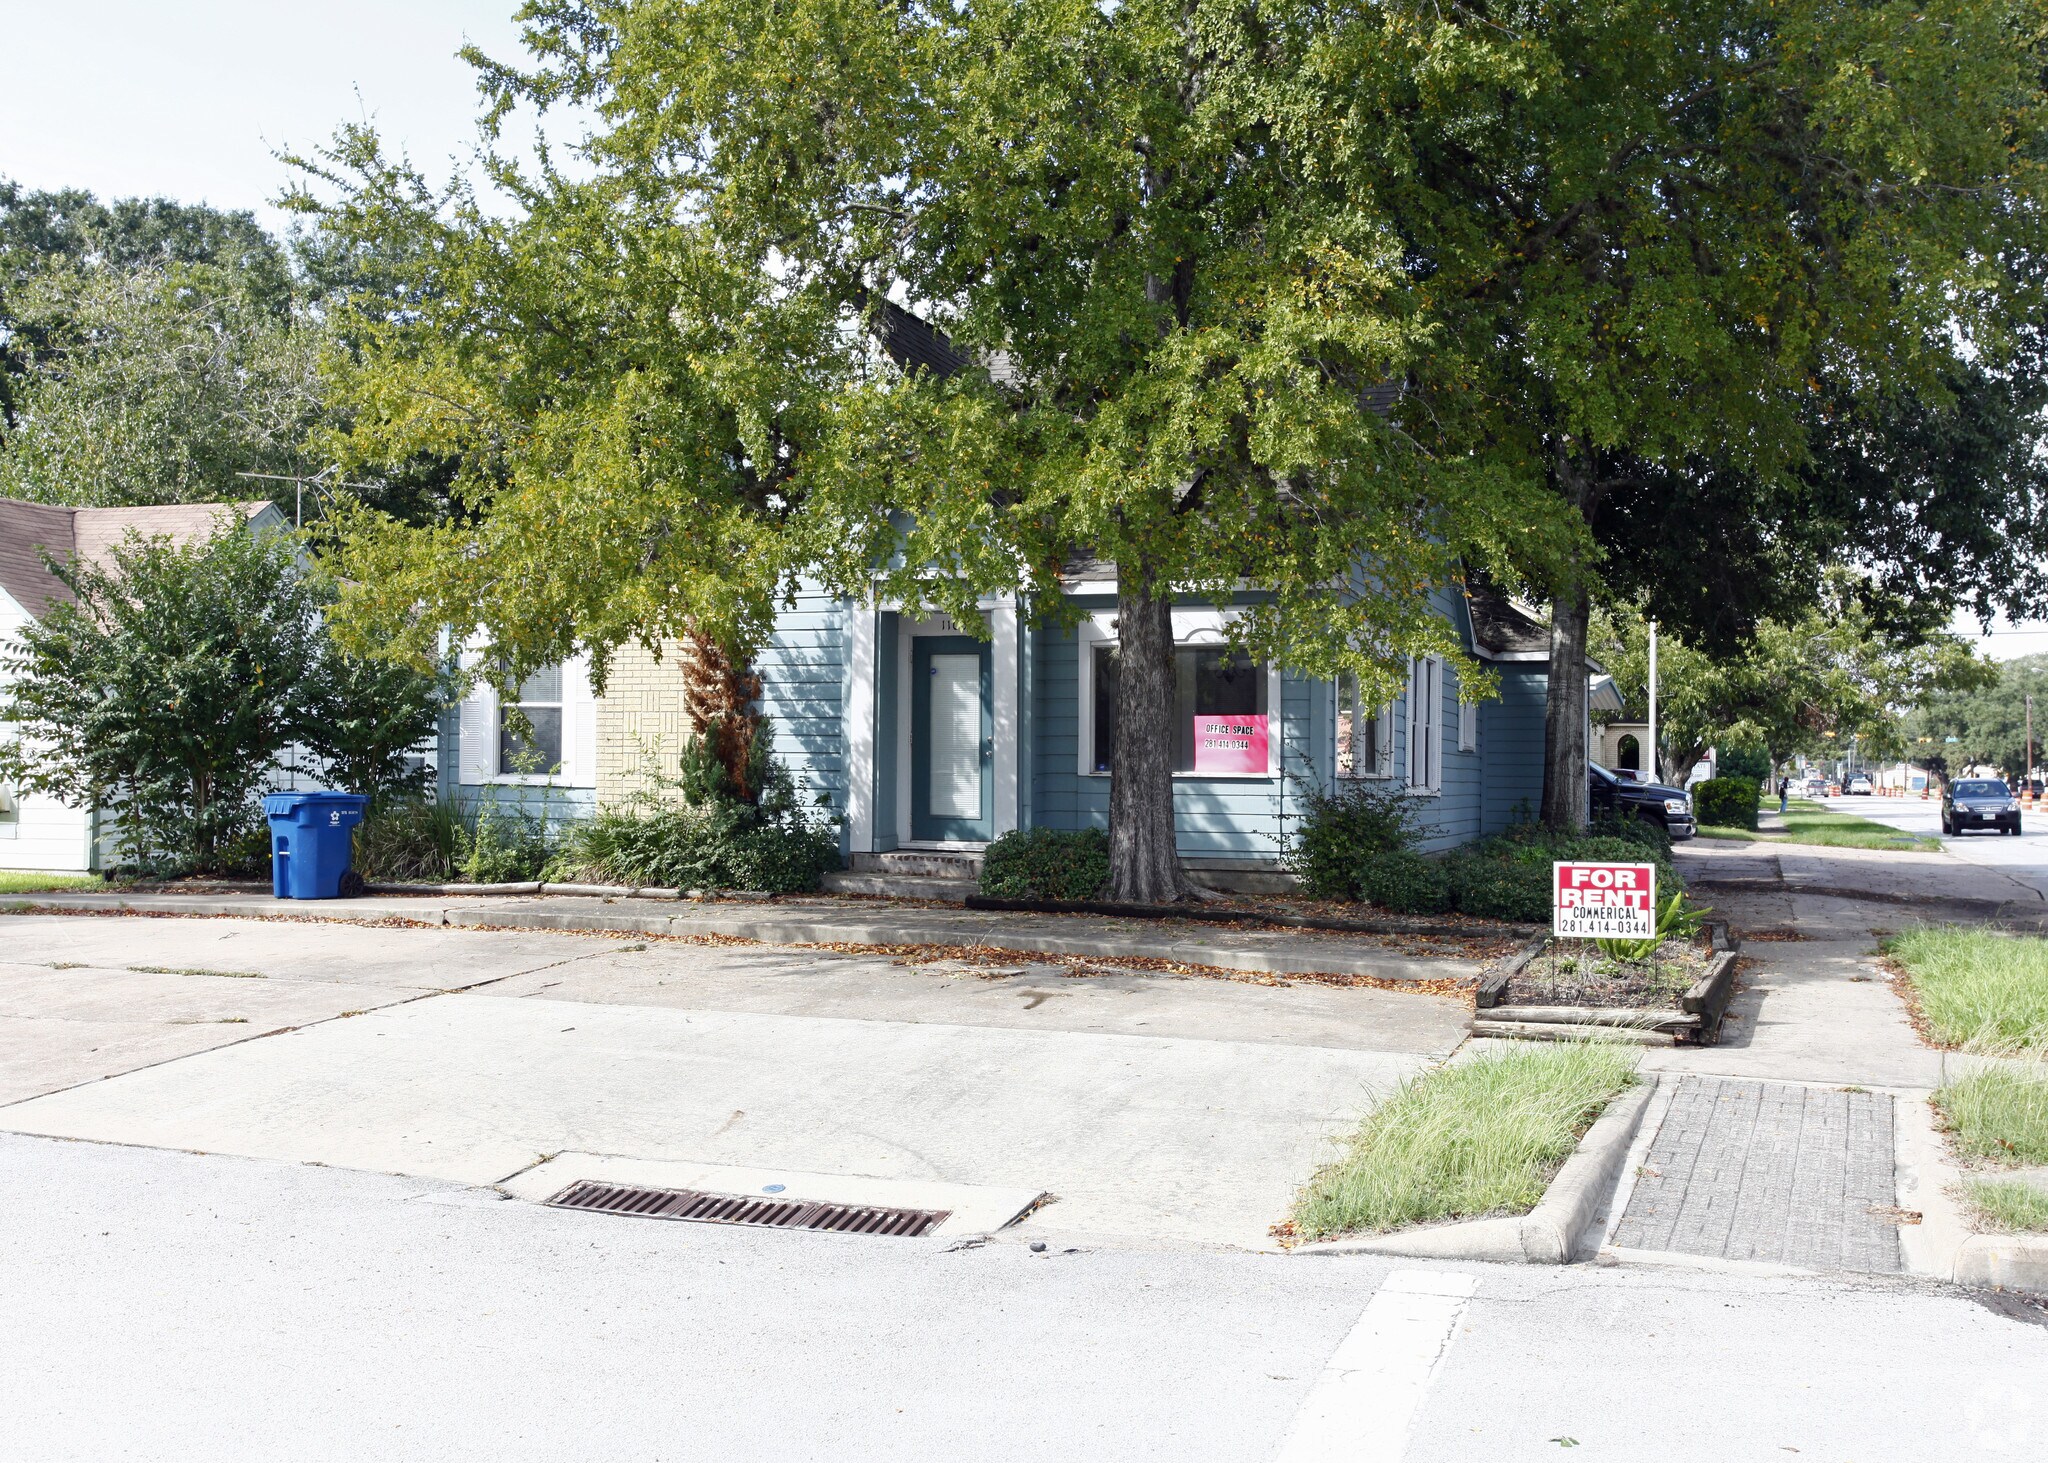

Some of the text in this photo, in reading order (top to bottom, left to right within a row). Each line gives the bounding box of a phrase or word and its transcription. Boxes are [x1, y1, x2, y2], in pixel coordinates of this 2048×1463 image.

[1206, 724, 1254, 735] OFFICE SPACE
[1205, 739, 1249, 750] 281 414 0344
[1571, 869, 1637, 889] FOR
[1561, 888, 1648, 909] RENT
[1573, 906, 1638, 920] COMMERICAL
